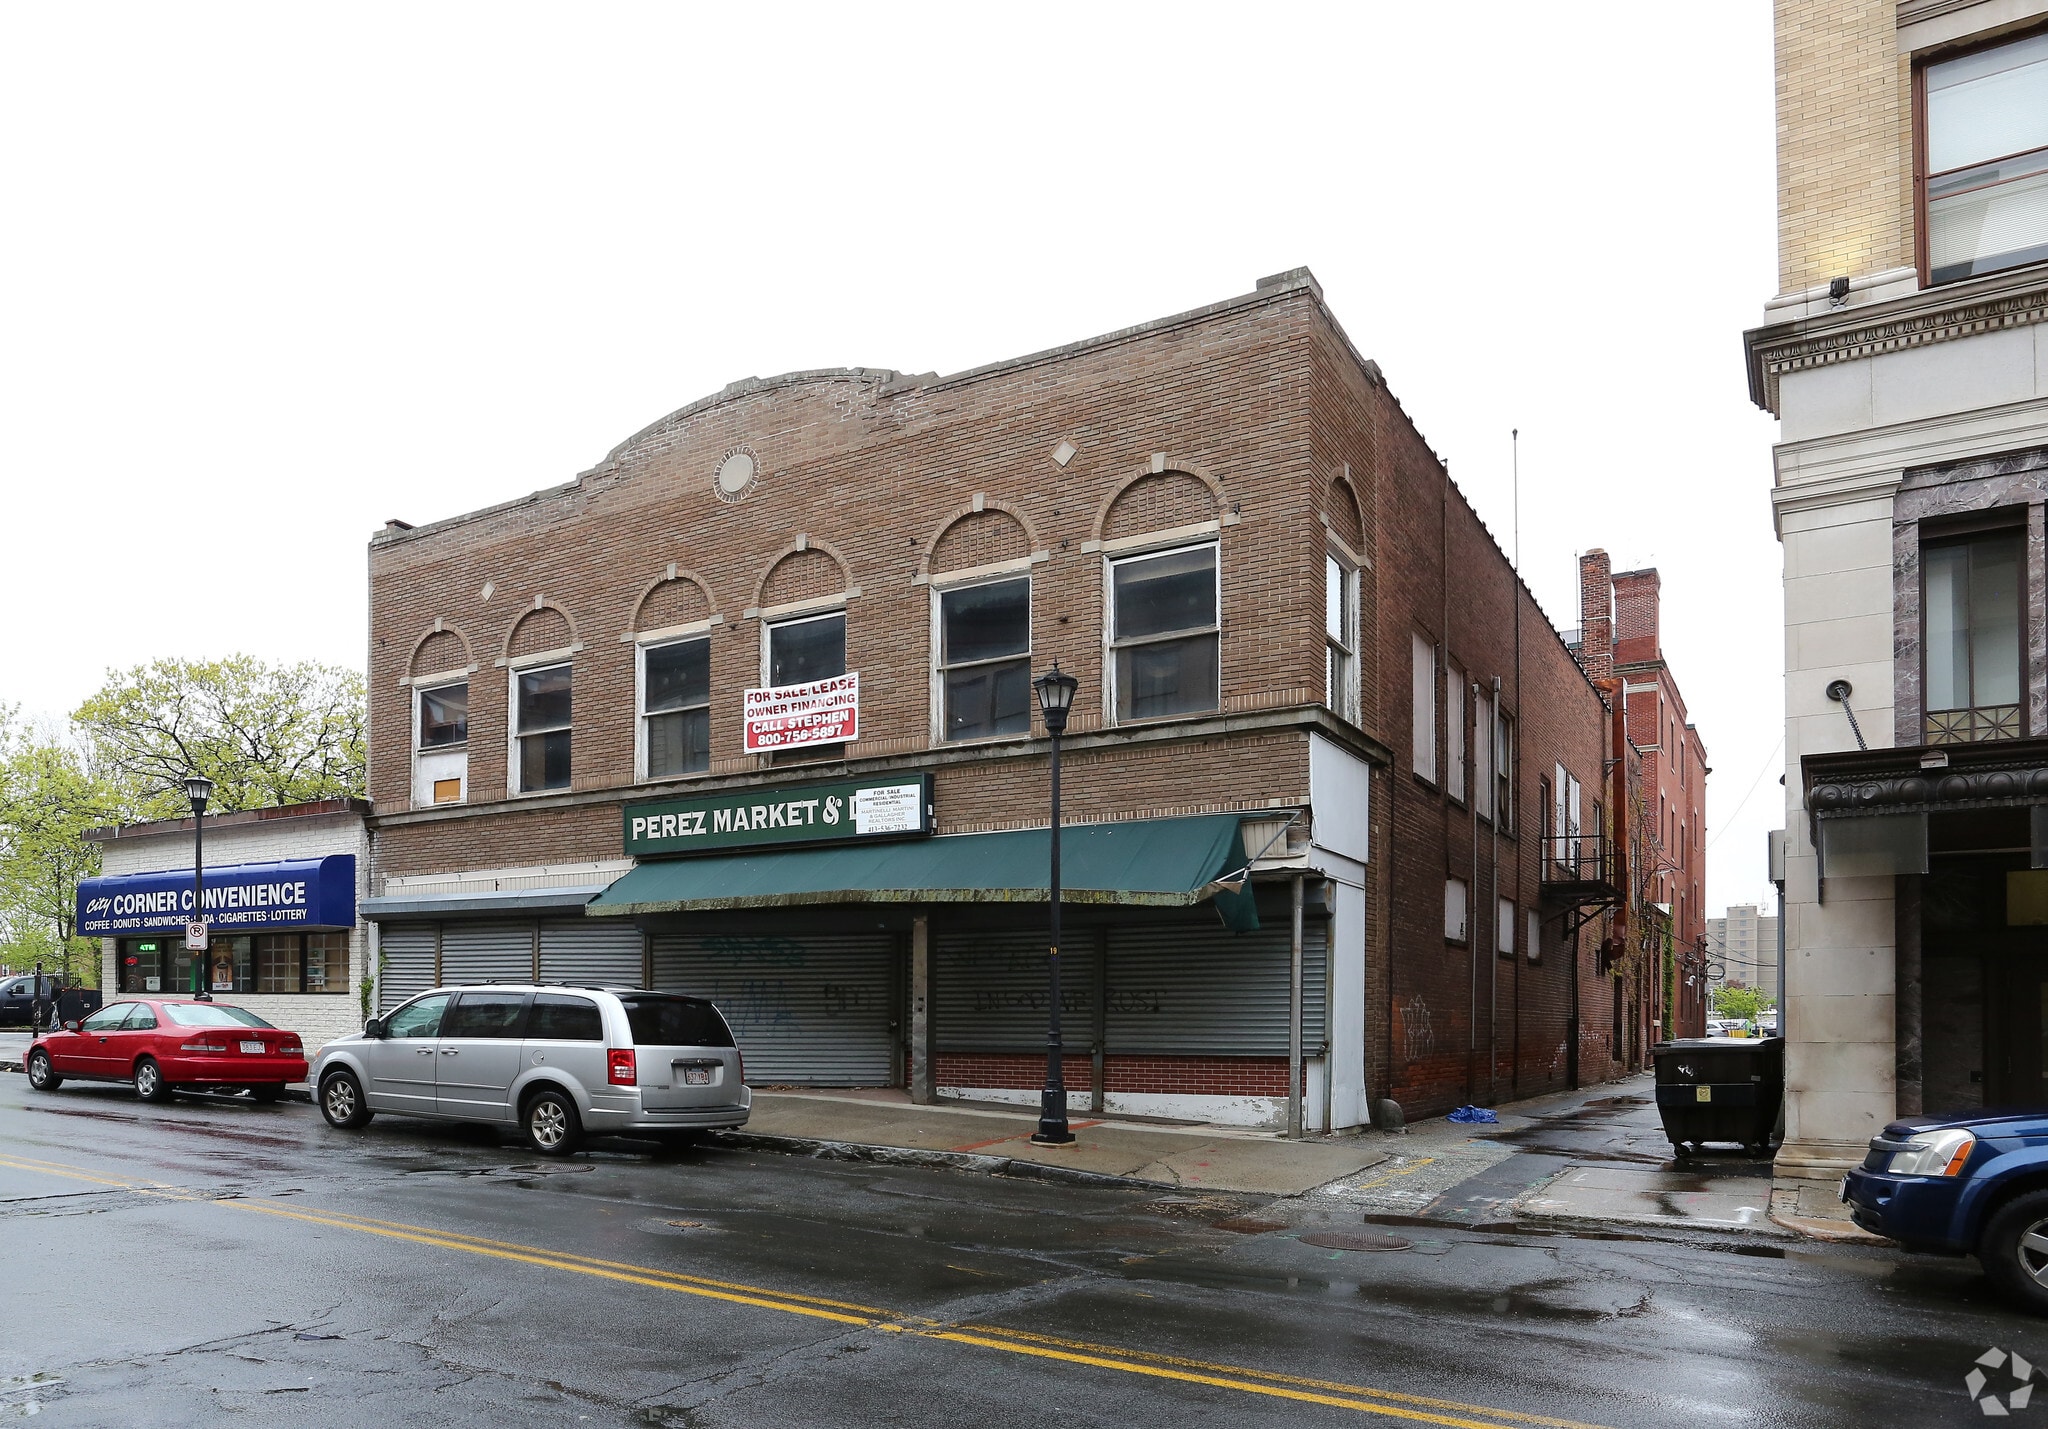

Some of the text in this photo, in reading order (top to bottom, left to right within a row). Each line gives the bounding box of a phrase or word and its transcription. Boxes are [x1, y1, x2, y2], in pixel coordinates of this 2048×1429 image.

[747, 678, 856, 704] FOR SALE/LEASE
[747, 693, 855, 718] OWNER FINANCING
[752, 709, 850, 734] CALL STEPHEN
[757, 724, 843, 746] 800-756-5897
[631, 810, 707, 841] PEREZ
[713, 798, 819, 834] MARKET
[822, 795, 843, 826] &
[86, 881, 306, 918] City CORNER CONVENIENCE
[84, 919, 110, 931] COFFEE
[113, 917, 141, 929] DONUTS
[143, 914, 190, 927] SANDWICHES
[218, 910, 267, 924] CIGARETTES
[270, 908, 307, 921] LOTTERY
[139, 943, 156, 951] ATM
